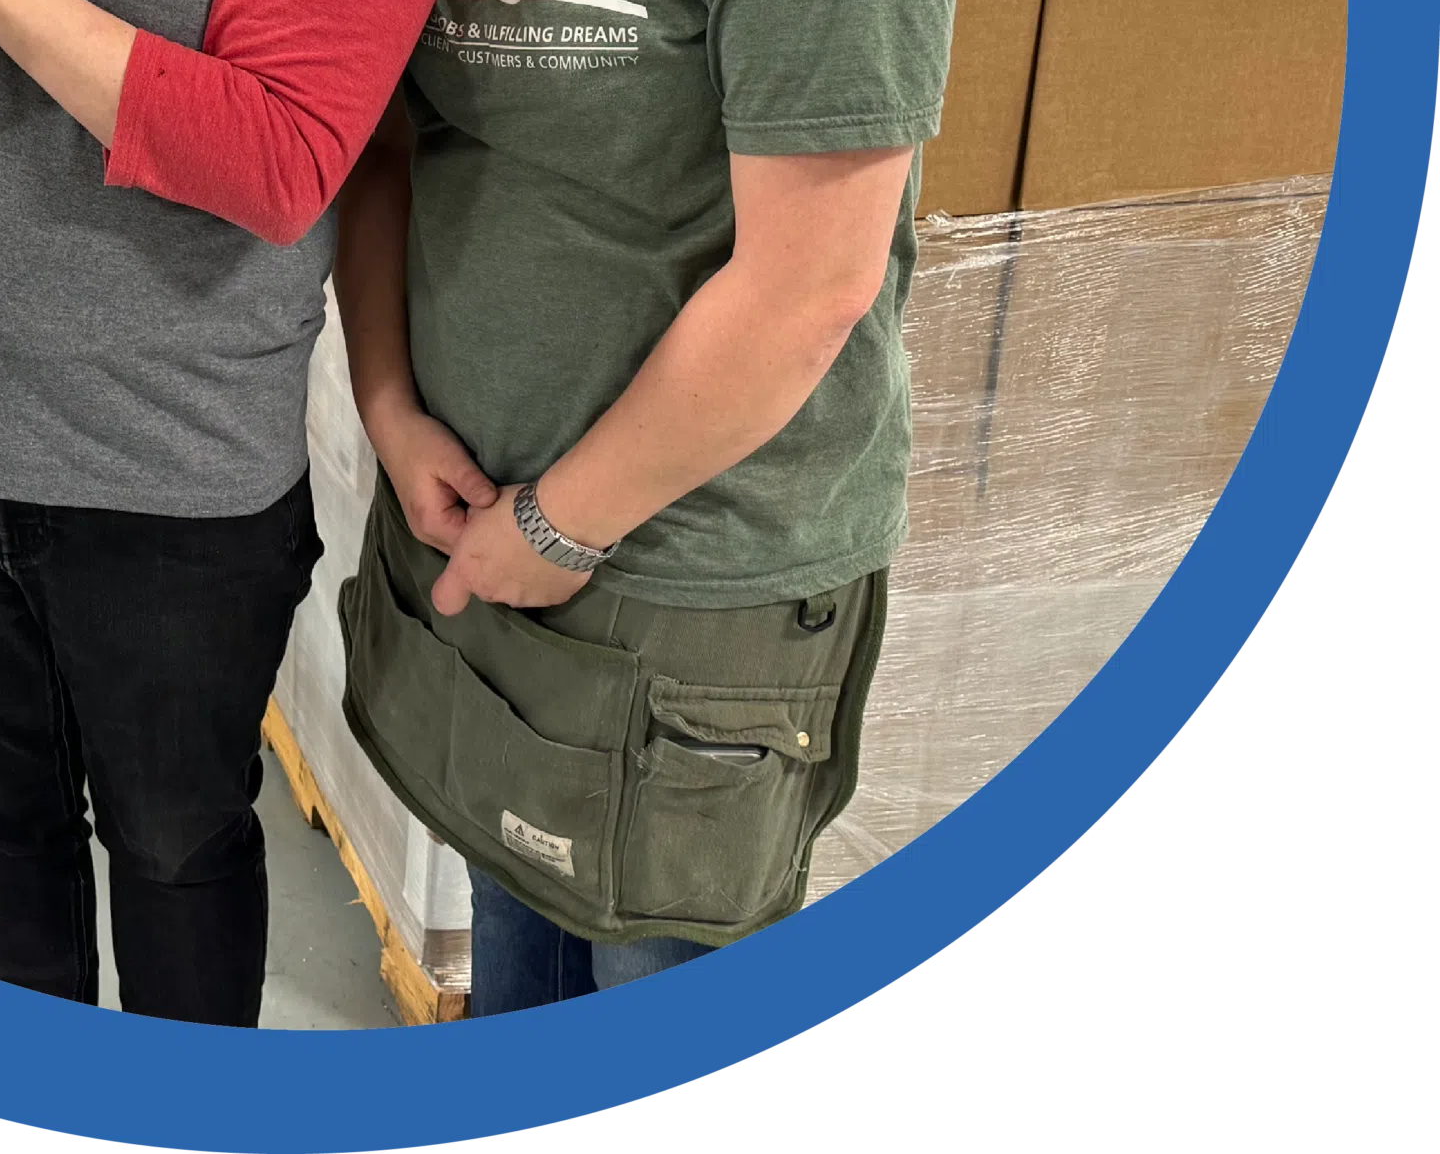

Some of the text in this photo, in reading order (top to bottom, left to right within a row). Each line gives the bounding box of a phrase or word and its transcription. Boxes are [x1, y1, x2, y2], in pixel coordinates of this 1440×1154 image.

[466, 22, 481, 39] &
[560, 26, 639, 44] DREAMS
[526, 55, 536, 68] &
[538, 55, 639, 70] COMMUNITY
